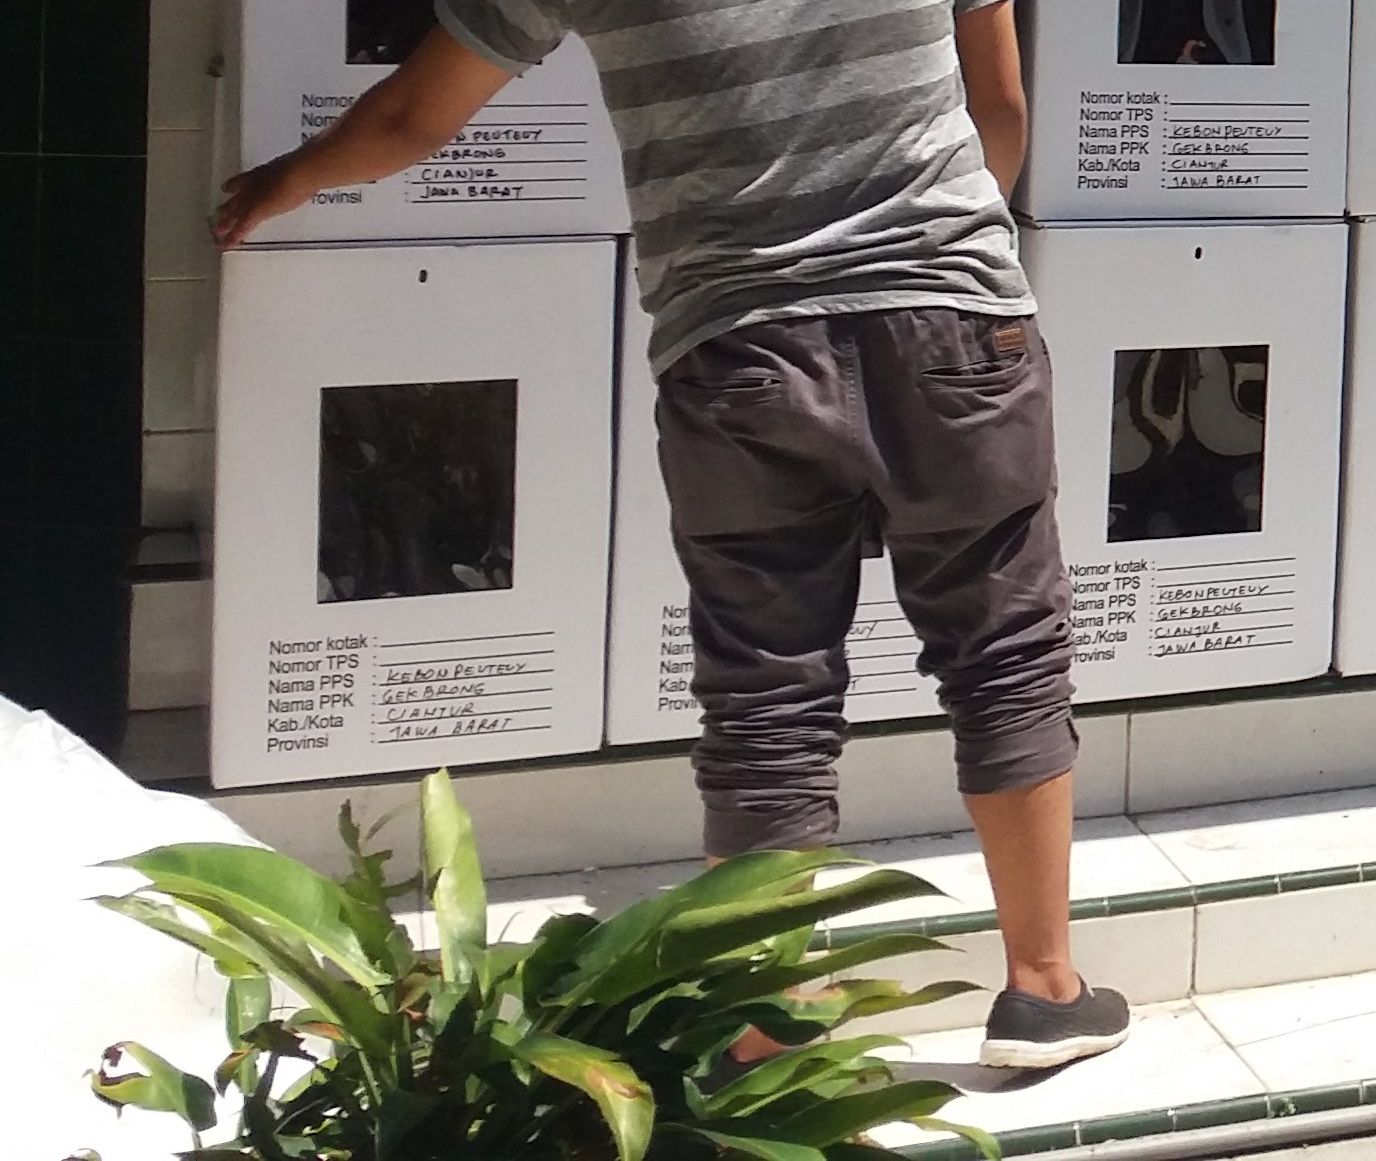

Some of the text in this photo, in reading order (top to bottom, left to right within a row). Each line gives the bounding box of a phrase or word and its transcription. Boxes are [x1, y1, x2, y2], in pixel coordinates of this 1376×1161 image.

[1080, 91, 1160, 104] Nomor kotak
[1080, 108, 1153, 121] Nomor TPS
[1079, 124, 1149, 138] Nama PPS
[1079, 141, 1149, 154] Nama PPK
[1078, 158, 1140, 171] Kab./Kota
[1077, 175, 1128, 188] Provinsi
[270, 634, 367, 654] Nomor kotak
[269, 653, 359, 674] Nomor TPS
[269, 673, 354, 694] Nama PPS
[268, 693, 353, 713] Nama PPK
[268, 715, 343, 732] Kab./Kota
[267, 735, 328, 752] Provinsi
